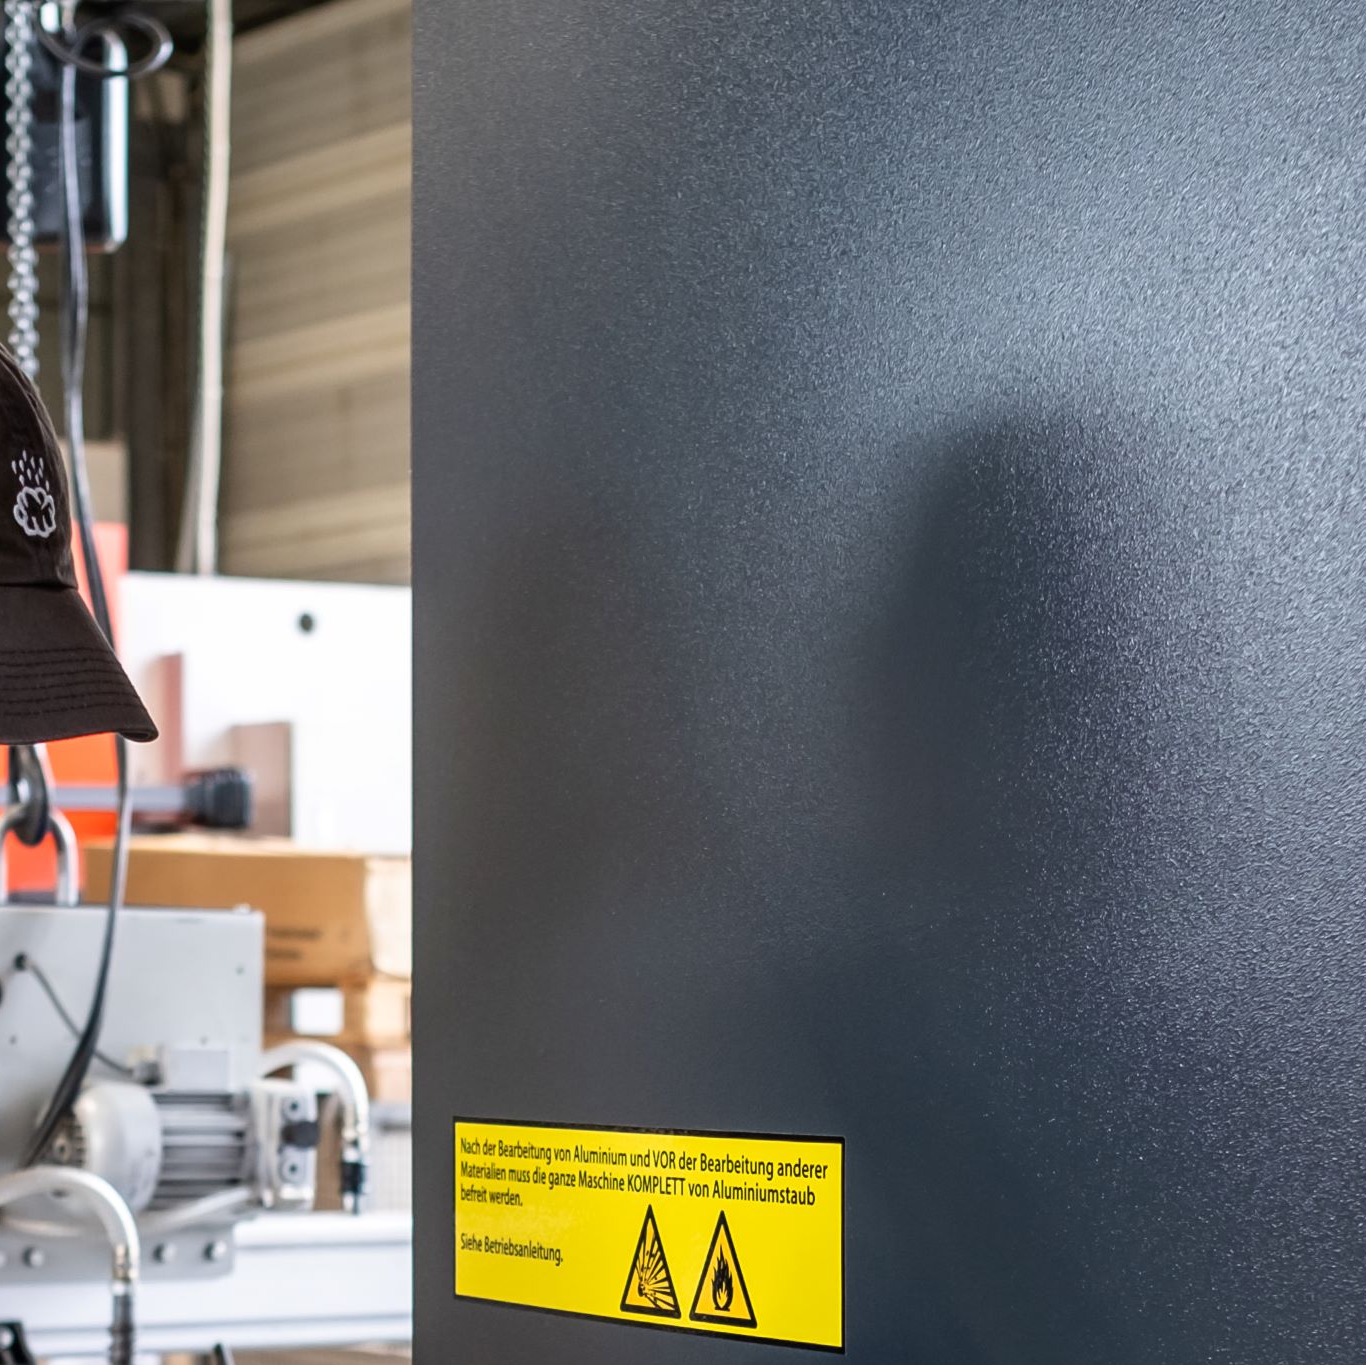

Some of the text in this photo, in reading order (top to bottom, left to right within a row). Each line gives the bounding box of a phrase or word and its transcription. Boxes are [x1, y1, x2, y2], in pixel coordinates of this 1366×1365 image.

[460, 1137, 829, 1181] Nach der Bearbeitung von Aluminium und VOR der Bearbeitung anderer
[460, 1161, 816, 1206] Materialien muss die ganze Maschine KOMPLETT von Aluminiumstaub
[460, 1183, 524, 1207] befreit werden.
[460, 1232, 564, 1267] Siehe Betriebsanleitung.
